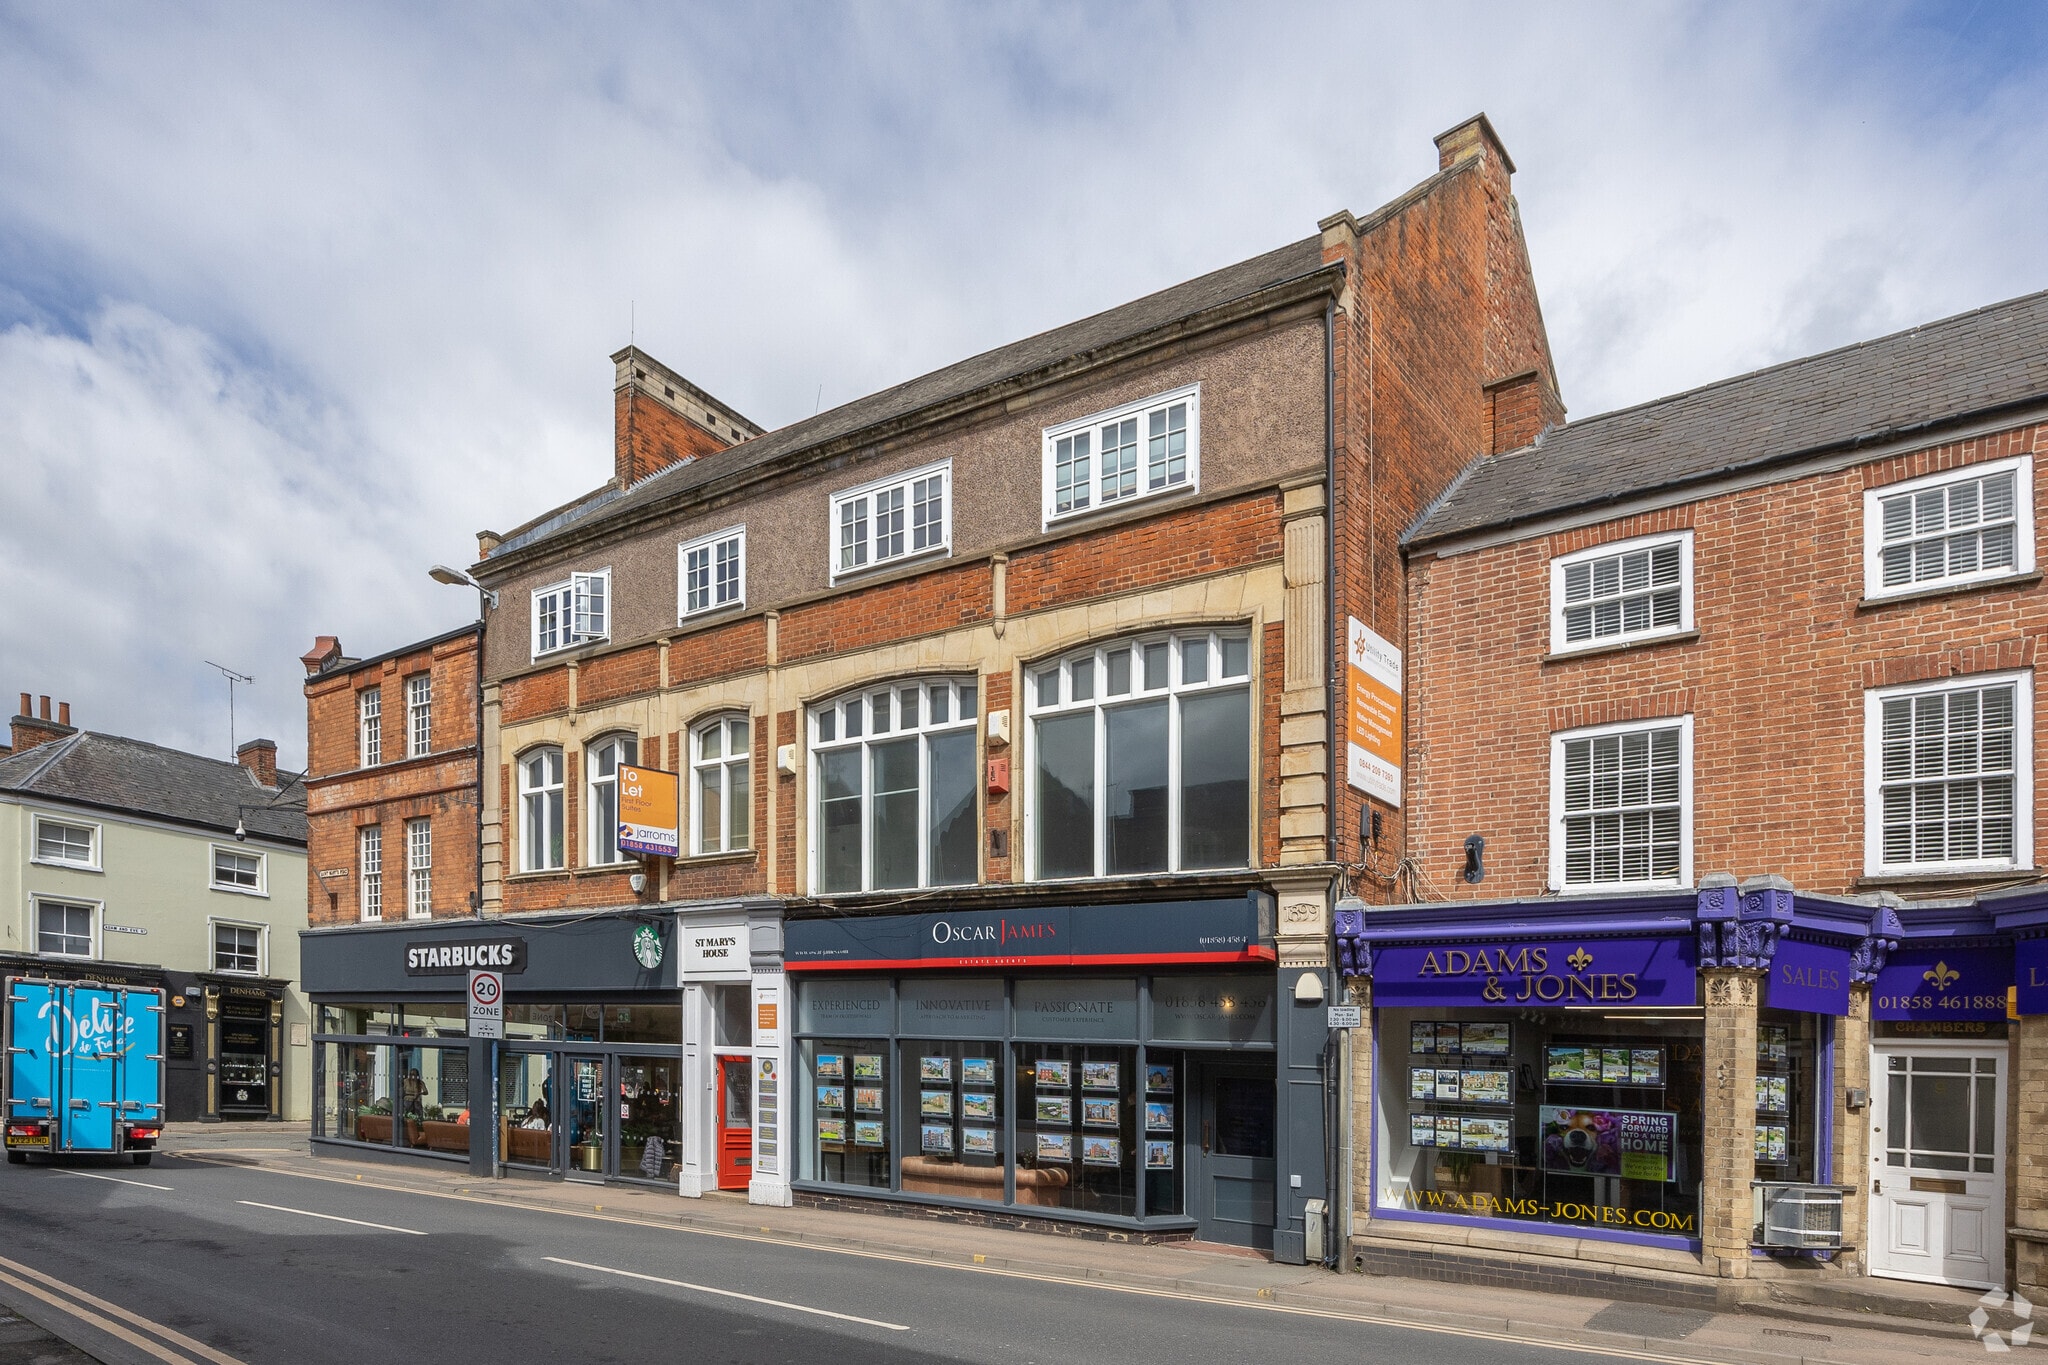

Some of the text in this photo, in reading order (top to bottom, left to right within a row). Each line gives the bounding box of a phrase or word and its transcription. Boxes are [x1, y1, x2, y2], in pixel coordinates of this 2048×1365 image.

[621, 768, 638, 782] To
[622, 782, 643, 798] Let
[621, 804, 642, 813] Suites
[636, 828, 676, 843] jarroms
[621, 840, 673, 853] 01858 431553
[695, 937, 736, 947] ST MARY'S
[408, 944, 513, 968] STARBUCKS
[702, 949, 729, 958] HOUSE
[1418, 947, 1548, 975] ADAMS
[84, 973, 127, 984] DENHAMS
[1782, 964, 1840, 990] SALES
[230, 986, 266, 997] DENHAMS
[476, 982, 497, 996] 20
[1482, 973, 1638, 1001] & JONES
[812, 1000, 881, 1011] EXPERIENCED
[916, 999, 991, 1011] INNOVATIVE
[1034, 1001, 1113, 1013] PASSIONATE
[1878, 995, 2008, 1009] 01858 461888
[473, 1006, 500, 1016] ZONE
[1895, 1021, 1986, 1033] CHAMBERS
[79, 1040, 91, 1053] de
[1622, 1114, 1668, 1126] SPRING
[1621, 1124, 1668, 1134] FORWARD
[1621, 1138, 1668, 1153] HOME
[1384, 1187, 1695, 1231] WWW.ADAMS-JONES.COM
